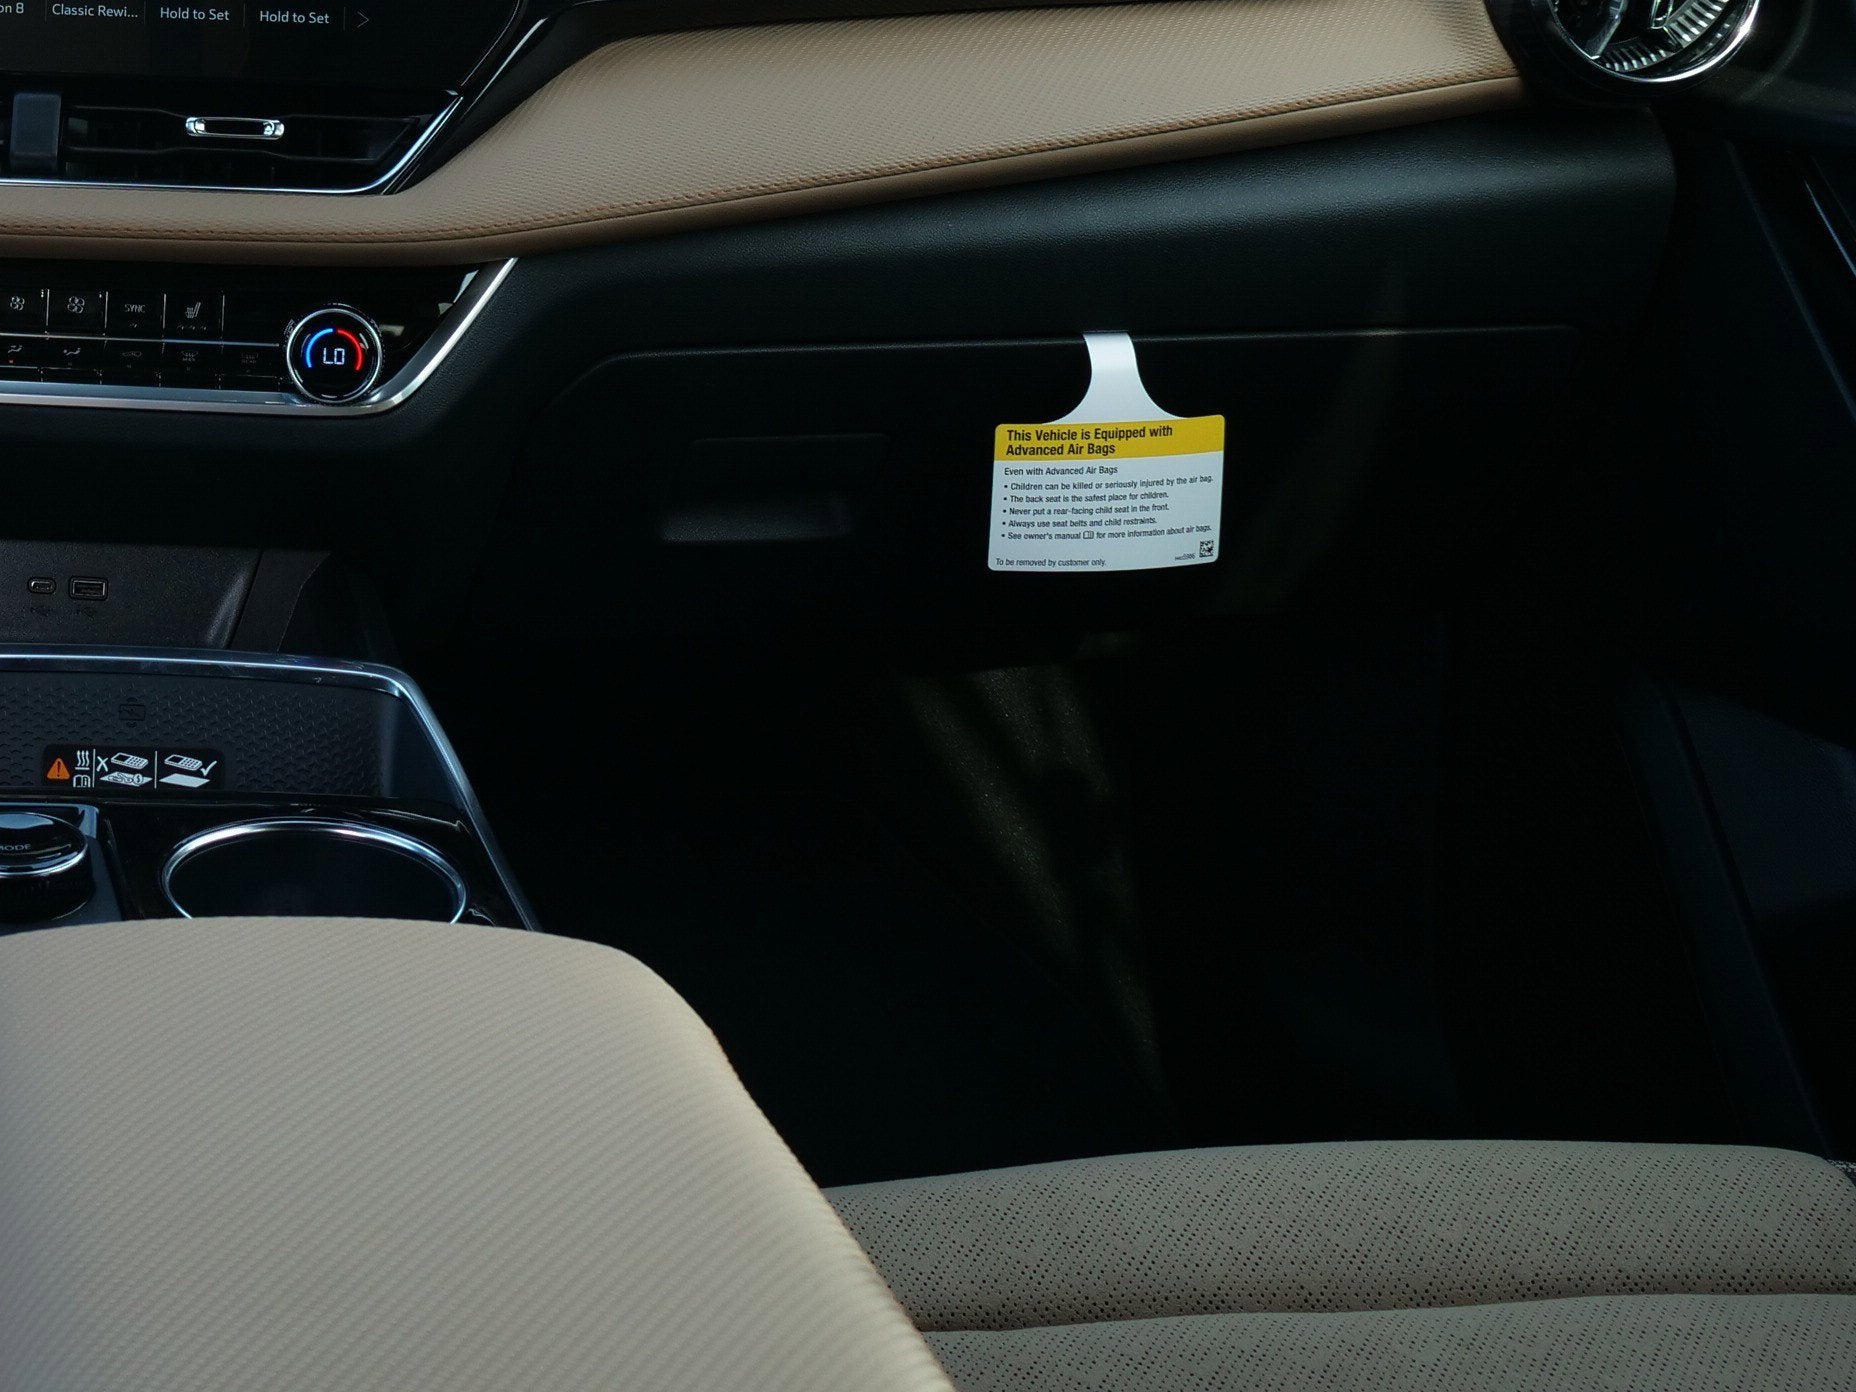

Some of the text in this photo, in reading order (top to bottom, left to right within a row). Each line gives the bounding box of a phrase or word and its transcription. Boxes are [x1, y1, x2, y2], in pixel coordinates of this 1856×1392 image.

[16, 3, 24, 13] 8
[52, 4, 138, 18] Classic Rewi...
[160, 7, 229, 20] Hold to Set
[260, 11, 329, 24] Hold to Set
[322, 348, 345, 365] LO
[1007, 426, 1172, 441] This Vehicle is Equipped with
[1006, 444, 1115, 456] Advanced Air Bags
[1045, 467, 1084, 475] Advanced
[1099, 466, 1118, 475] Bags
[1061, 482, 1070, 490] be
[1072, 481, 1093, 489] killed
[1105, 480, 1138, 489] seriously
[1140, 479, 1164, 487] injured
[1166, 478, 1175, 487] by
[1176, 477, 1187, 485] the
[1200, 475, 1213, 483] bag.
[1071, 494, 1082, 502] the
[1108, 494, 1127, 502] place
[1140, 491, 1169, 499] children.
[1033, 508, 1044, 516] put
[1053, 507, 1093, 515] rear-facing
[1114, 505, 1129, 513] seat
[1008, 520, 1034, 528] Always
[1104, 518, 1121, 526] child
[1123, 517, 1157, 525] restraints.
[1096, 531, 1105, 539] for
[1127, 528, 1165, 538] information
[1166, 527, 1185, 535] about
[1196, 524, 1211, 533] bags.
[996, 558, 1106, 566] To be removed by customer only.
